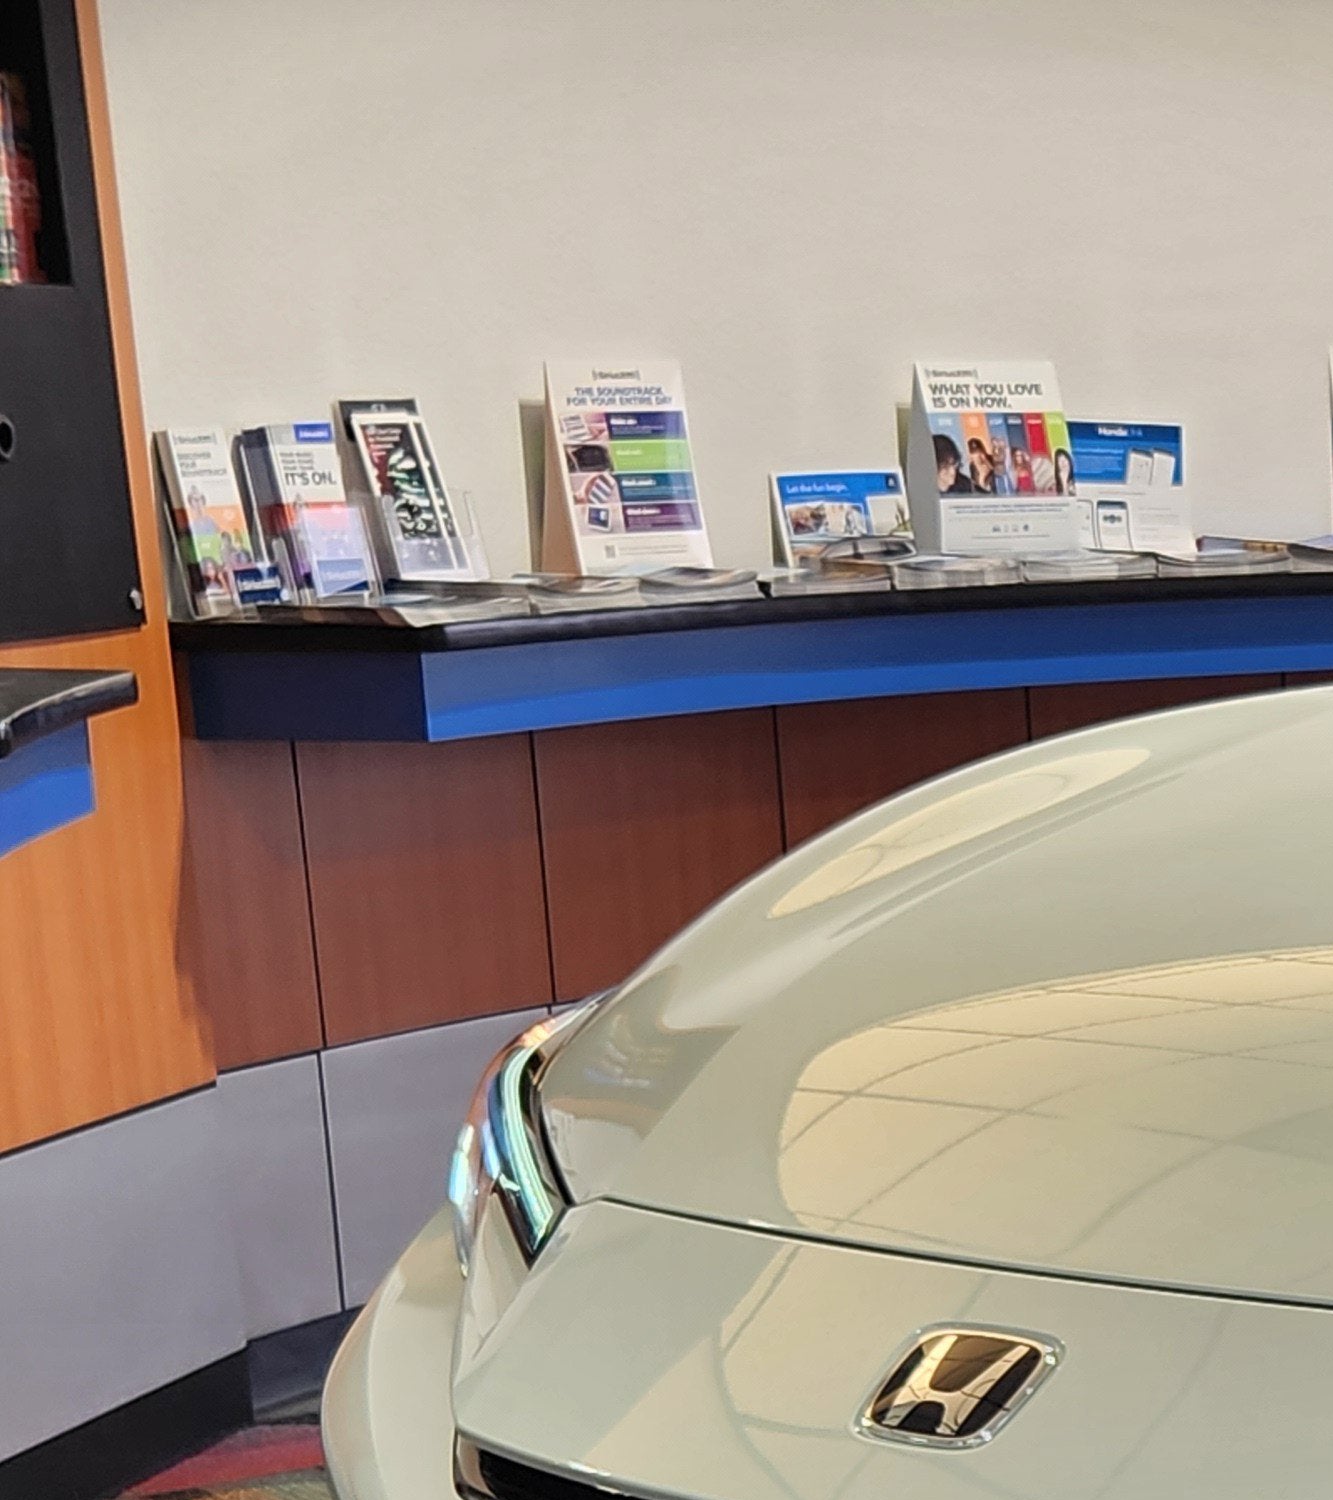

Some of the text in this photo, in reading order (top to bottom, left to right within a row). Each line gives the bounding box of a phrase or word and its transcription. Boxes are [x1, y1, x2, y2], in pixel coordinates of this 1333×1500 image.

[574, 386, 664, 396] THE SOUNDTRACK
[929, 383, 1043, 396] WHAT YOU LOVE
[566, 396, 673, 406] FOR YOUR ENTIRE DAY
[932, 397, 1012, 409] IS ON NOW.
[285, 471, 338, 486] IT'S ON.
[786, 484, 799, 494] Let
[800, 483, 813, 492] the
[813, 483, 825, 492] fun
